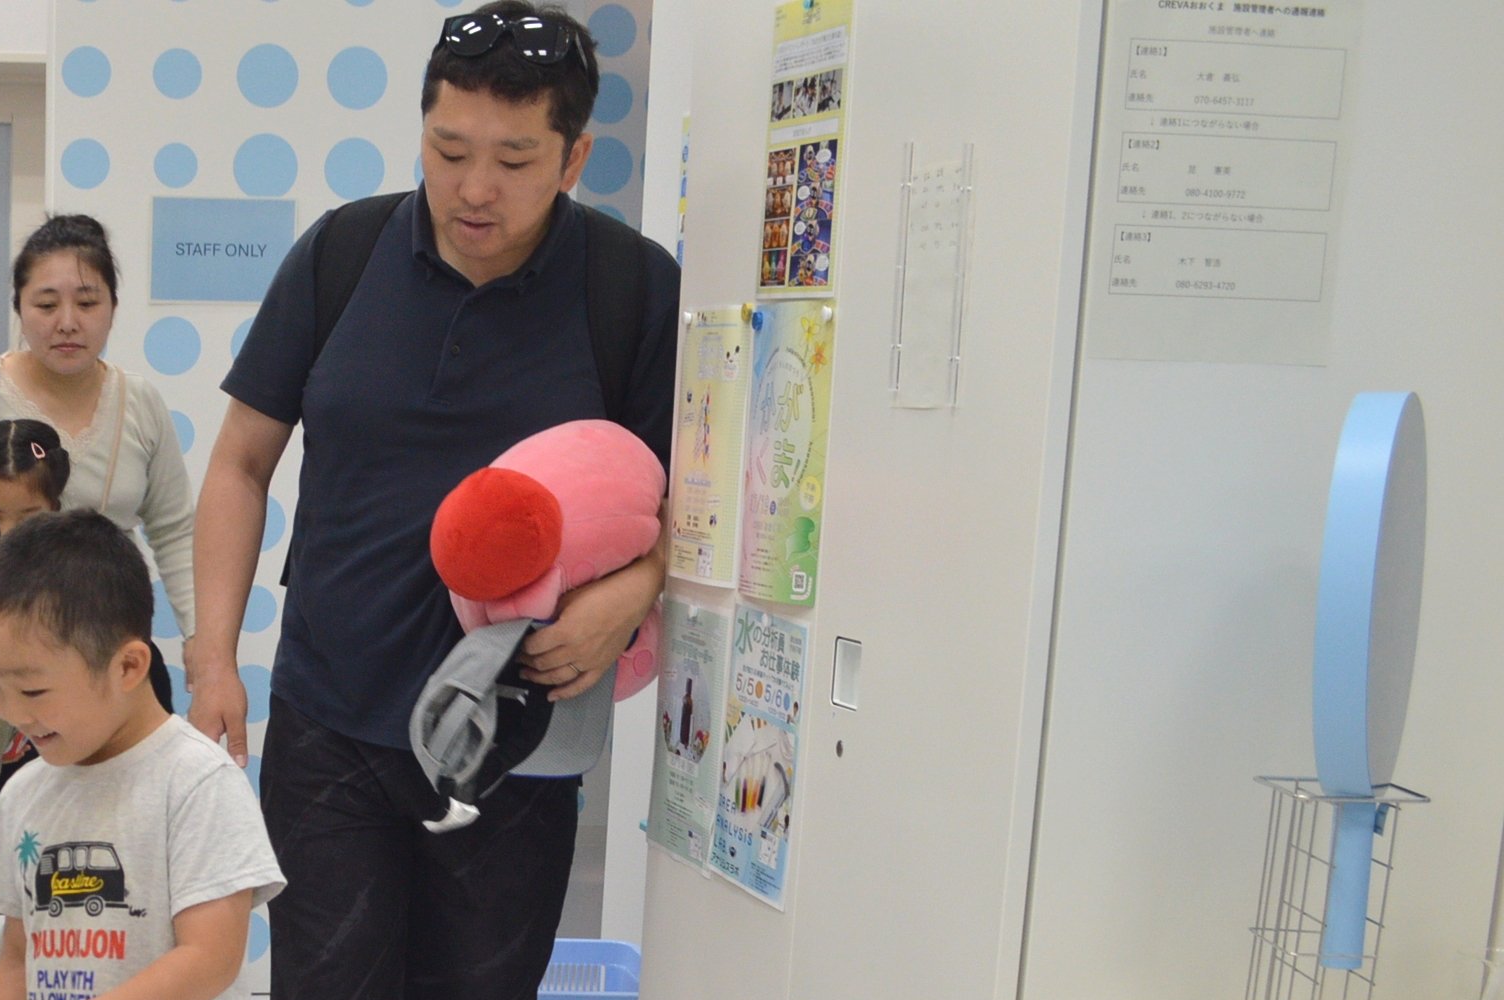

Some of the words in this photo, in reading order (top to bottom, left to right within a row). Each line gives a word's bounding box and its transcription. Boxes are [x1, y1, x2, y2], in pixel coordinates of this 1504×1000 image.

[175, 242, 221, 257] STAFF
[225, 243, 267, 258] ONLY
[37, 970, 68, 989] PLAY
